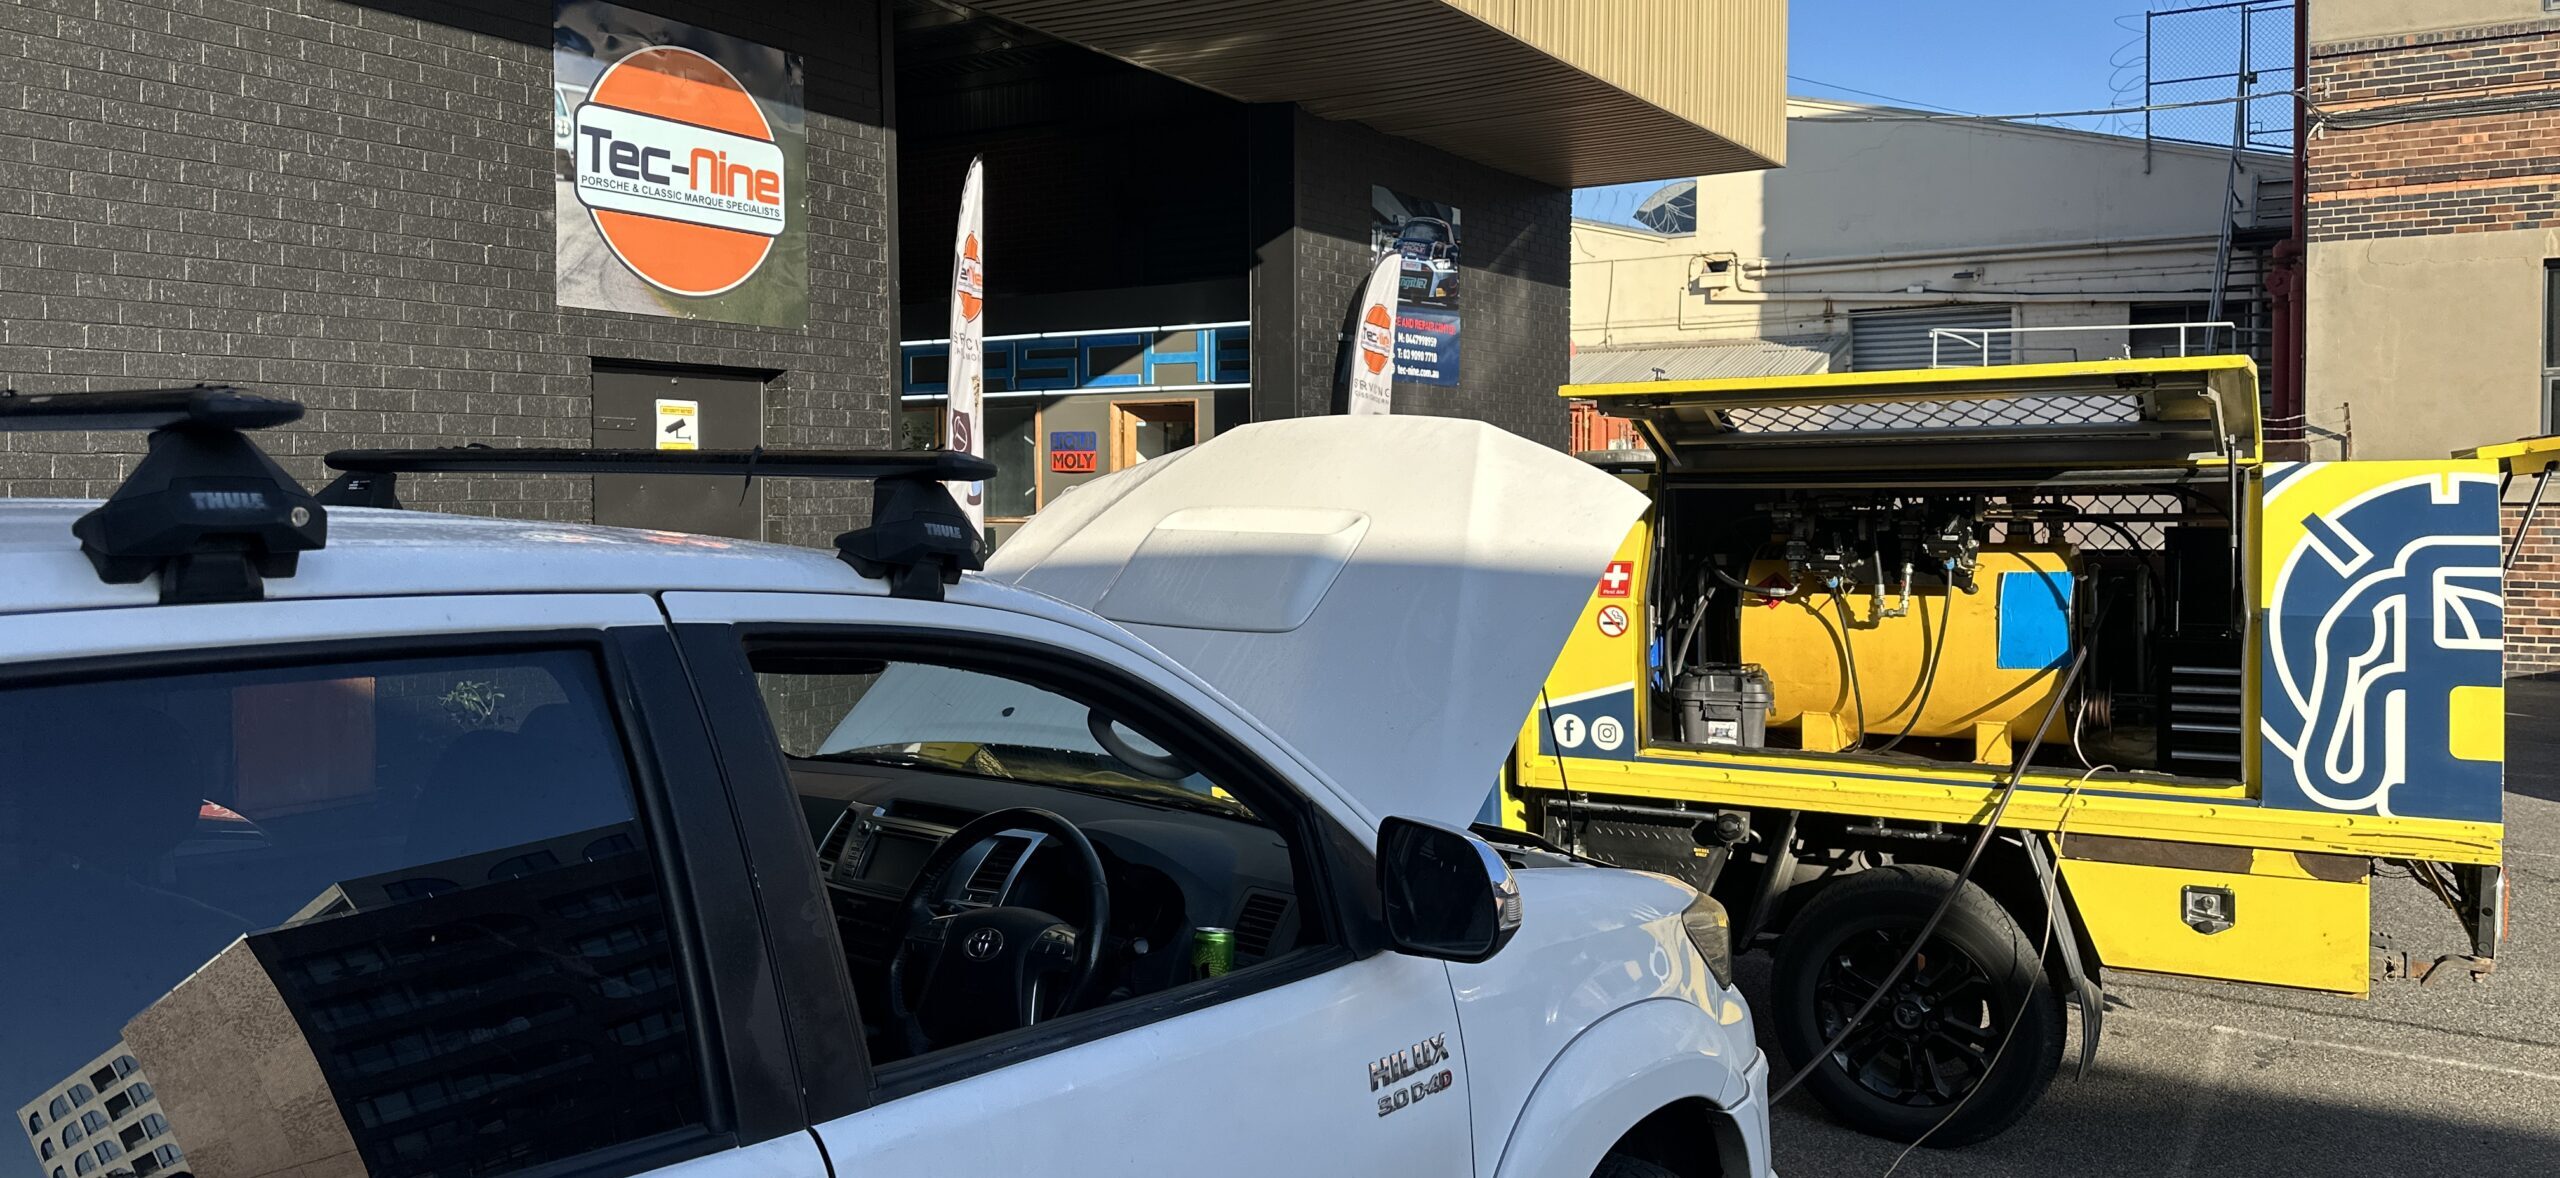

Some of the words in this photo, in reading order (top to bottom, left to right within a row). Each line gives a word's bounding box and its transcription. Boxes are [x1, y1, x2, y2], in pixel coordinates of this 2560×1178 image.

[580, 124, 780, 205] Tec-Nine
[581, 175, 630, 191] PORSCHE
[632, 184, 639, 193] &
[641, 185, 682, 200] CLASSIC
[684, 192, 724, 208] MARQUE
[726, 200, 780, 218] SPECIALISTS
[1053, 453, 1094, 469] MOLY
[190, 492, 266, 509] THULE
[924, 523, 962, 539] THULE
[1369, 1032, 1450, 1093] HILUX
